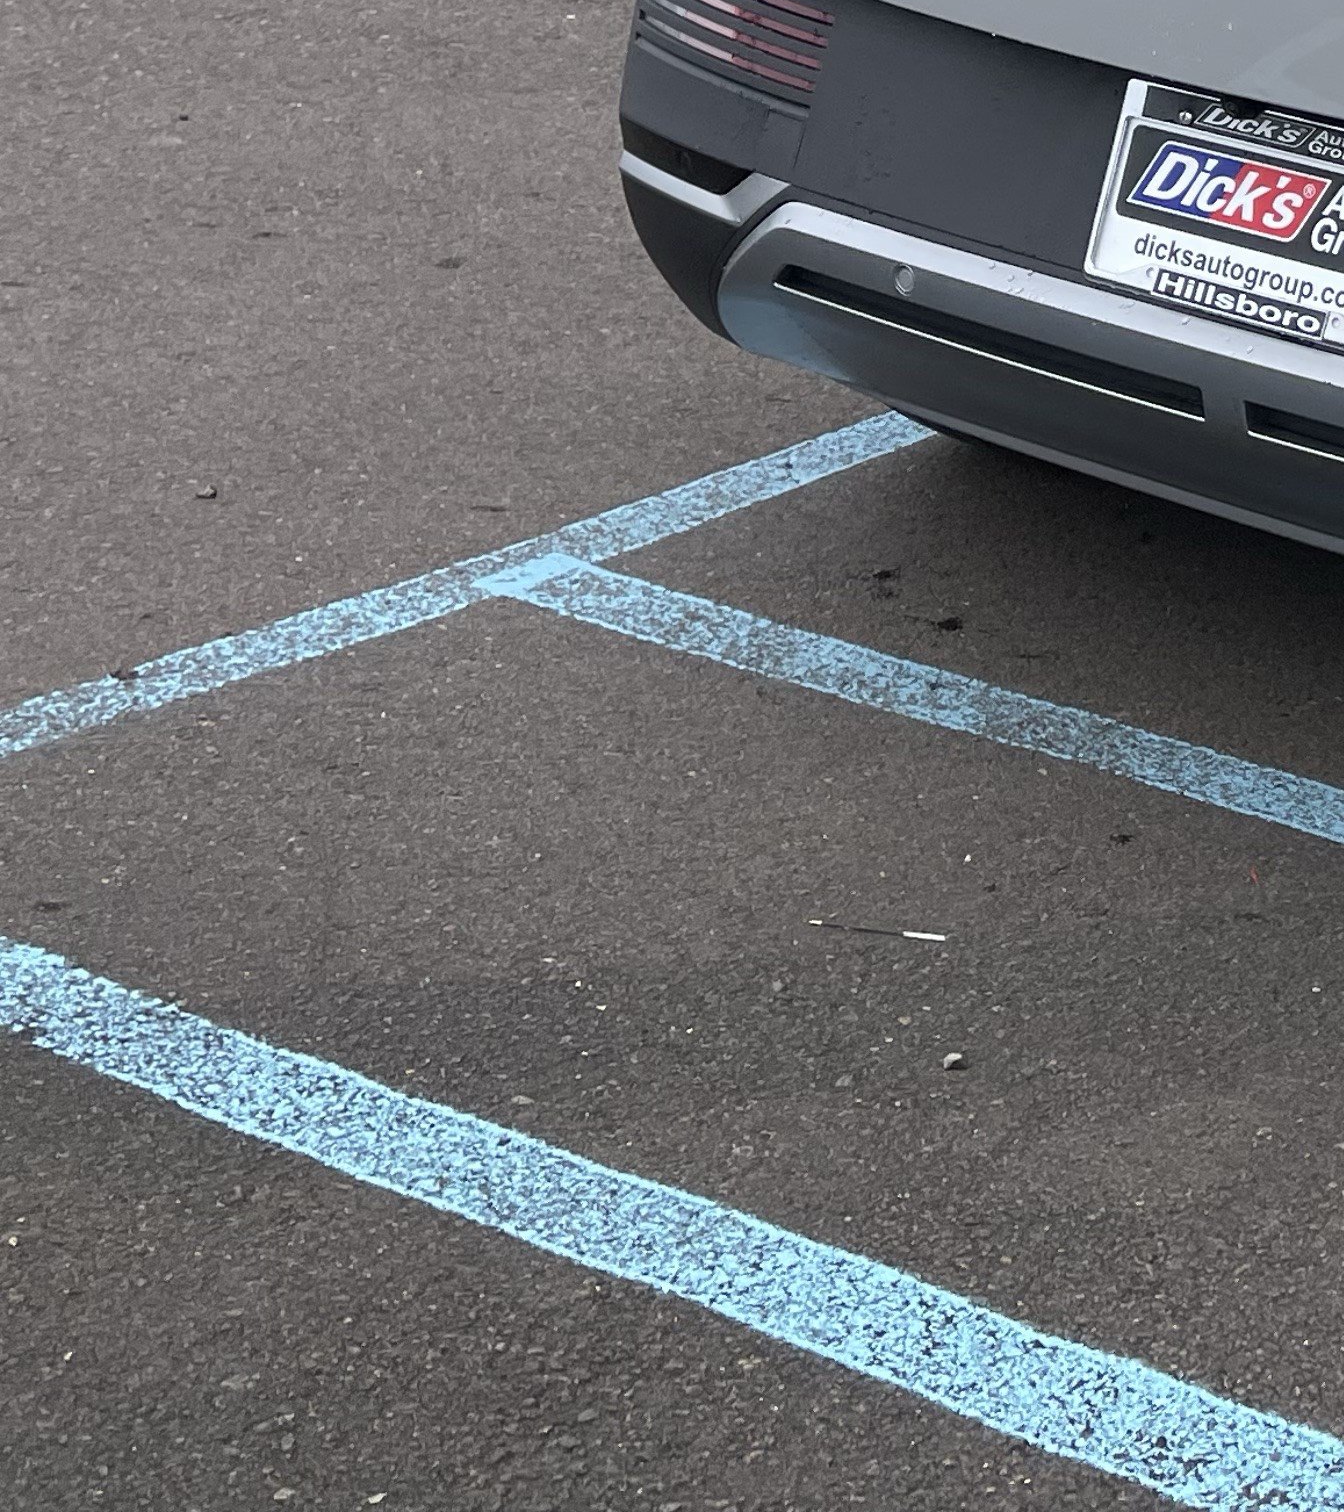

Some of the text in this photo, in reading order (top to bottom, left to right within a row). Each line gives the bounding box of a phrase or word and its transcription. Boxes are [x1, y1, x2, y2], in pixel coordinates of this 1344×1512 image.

[1202, 107, 1303, 144] Dick's
[1142, 151, 1304, 230] Dick's
[1156, 271, 1321, 334] Hillsboro
